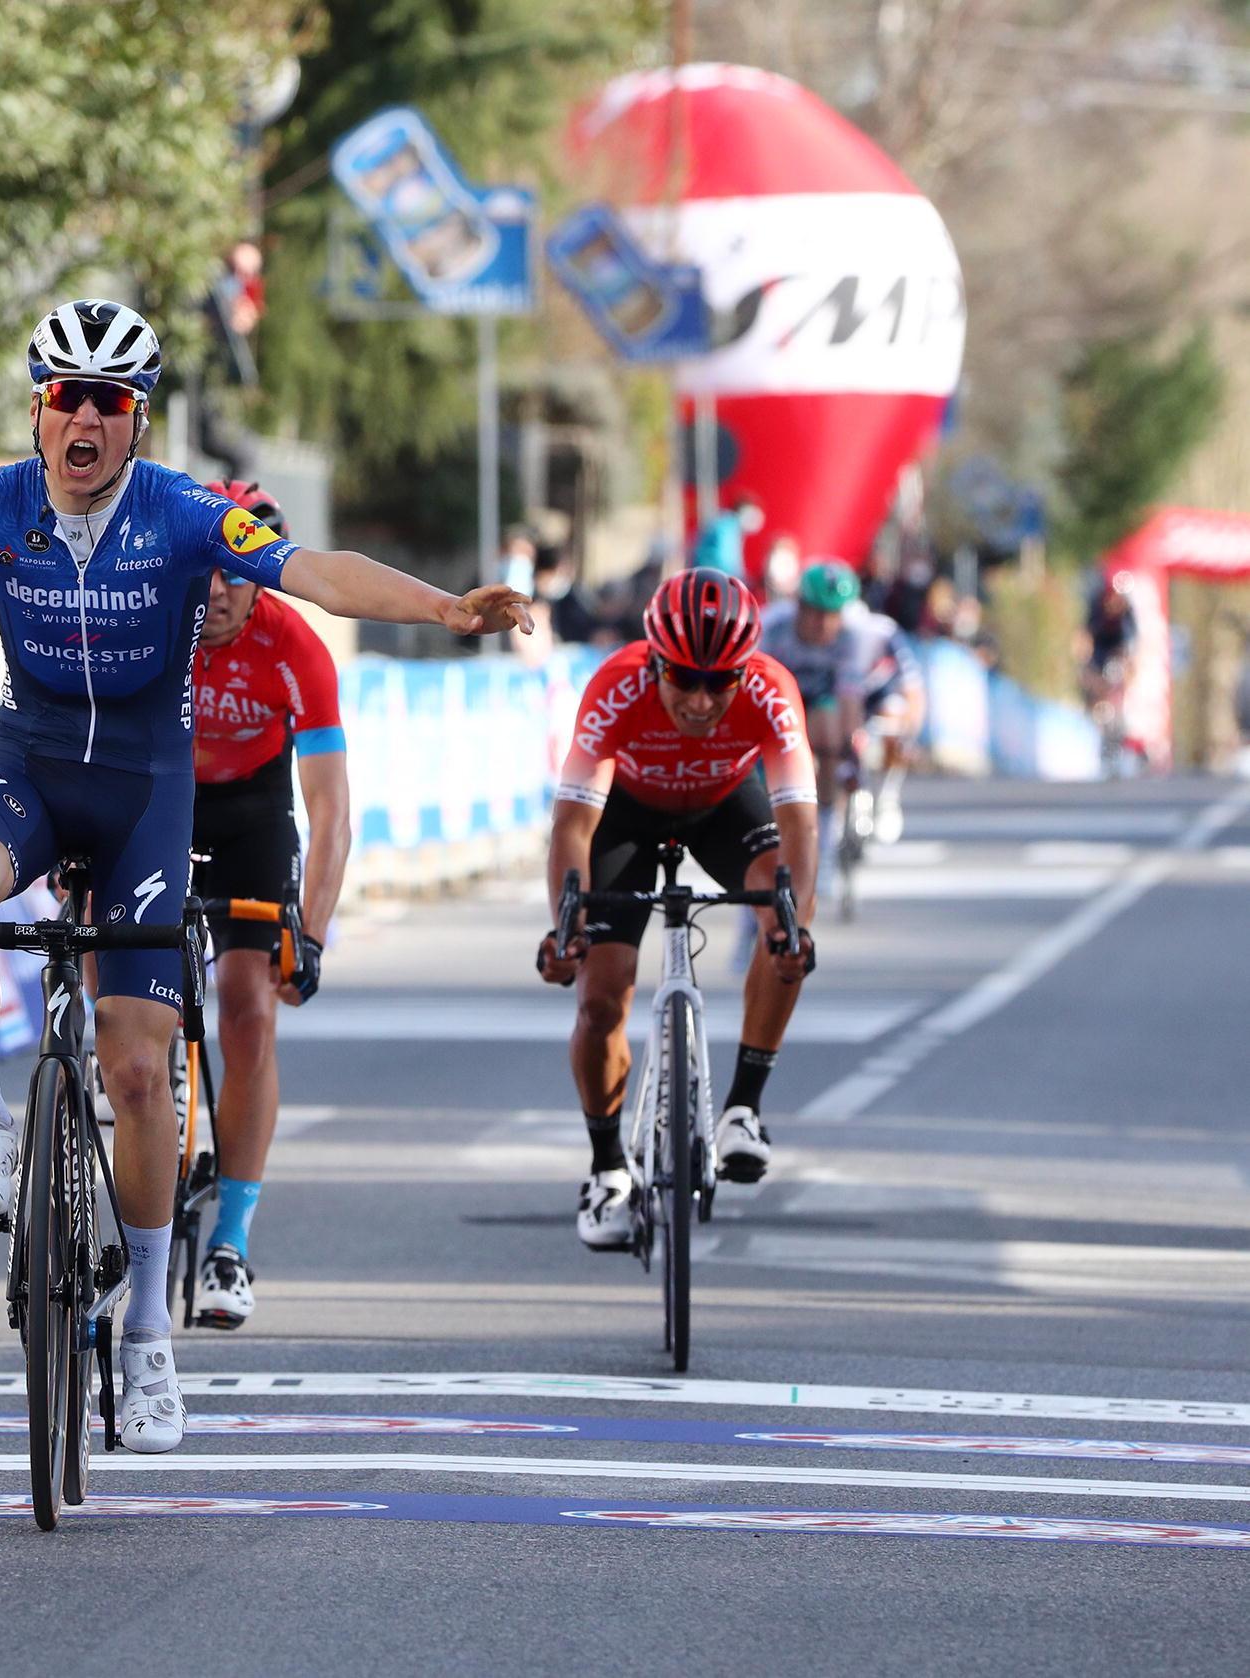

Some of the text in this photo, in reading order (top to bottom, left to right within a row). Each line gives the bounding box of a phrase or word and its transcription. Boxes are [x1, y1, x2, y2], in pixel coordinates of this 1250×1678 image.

[19, 557, 57, 566] NAPOLEON
[115, 557, 163, 571] latexco
[5, 577, 159, 611] deceuninck
[41, 613, 118, 627] WINDOWS
[60, 663, 118, 673] FLOORS
[192, 685, 275, 718] RAIN
[576, 666, 653, 756] ARKEA
[149, 978, 183, 1006] late
